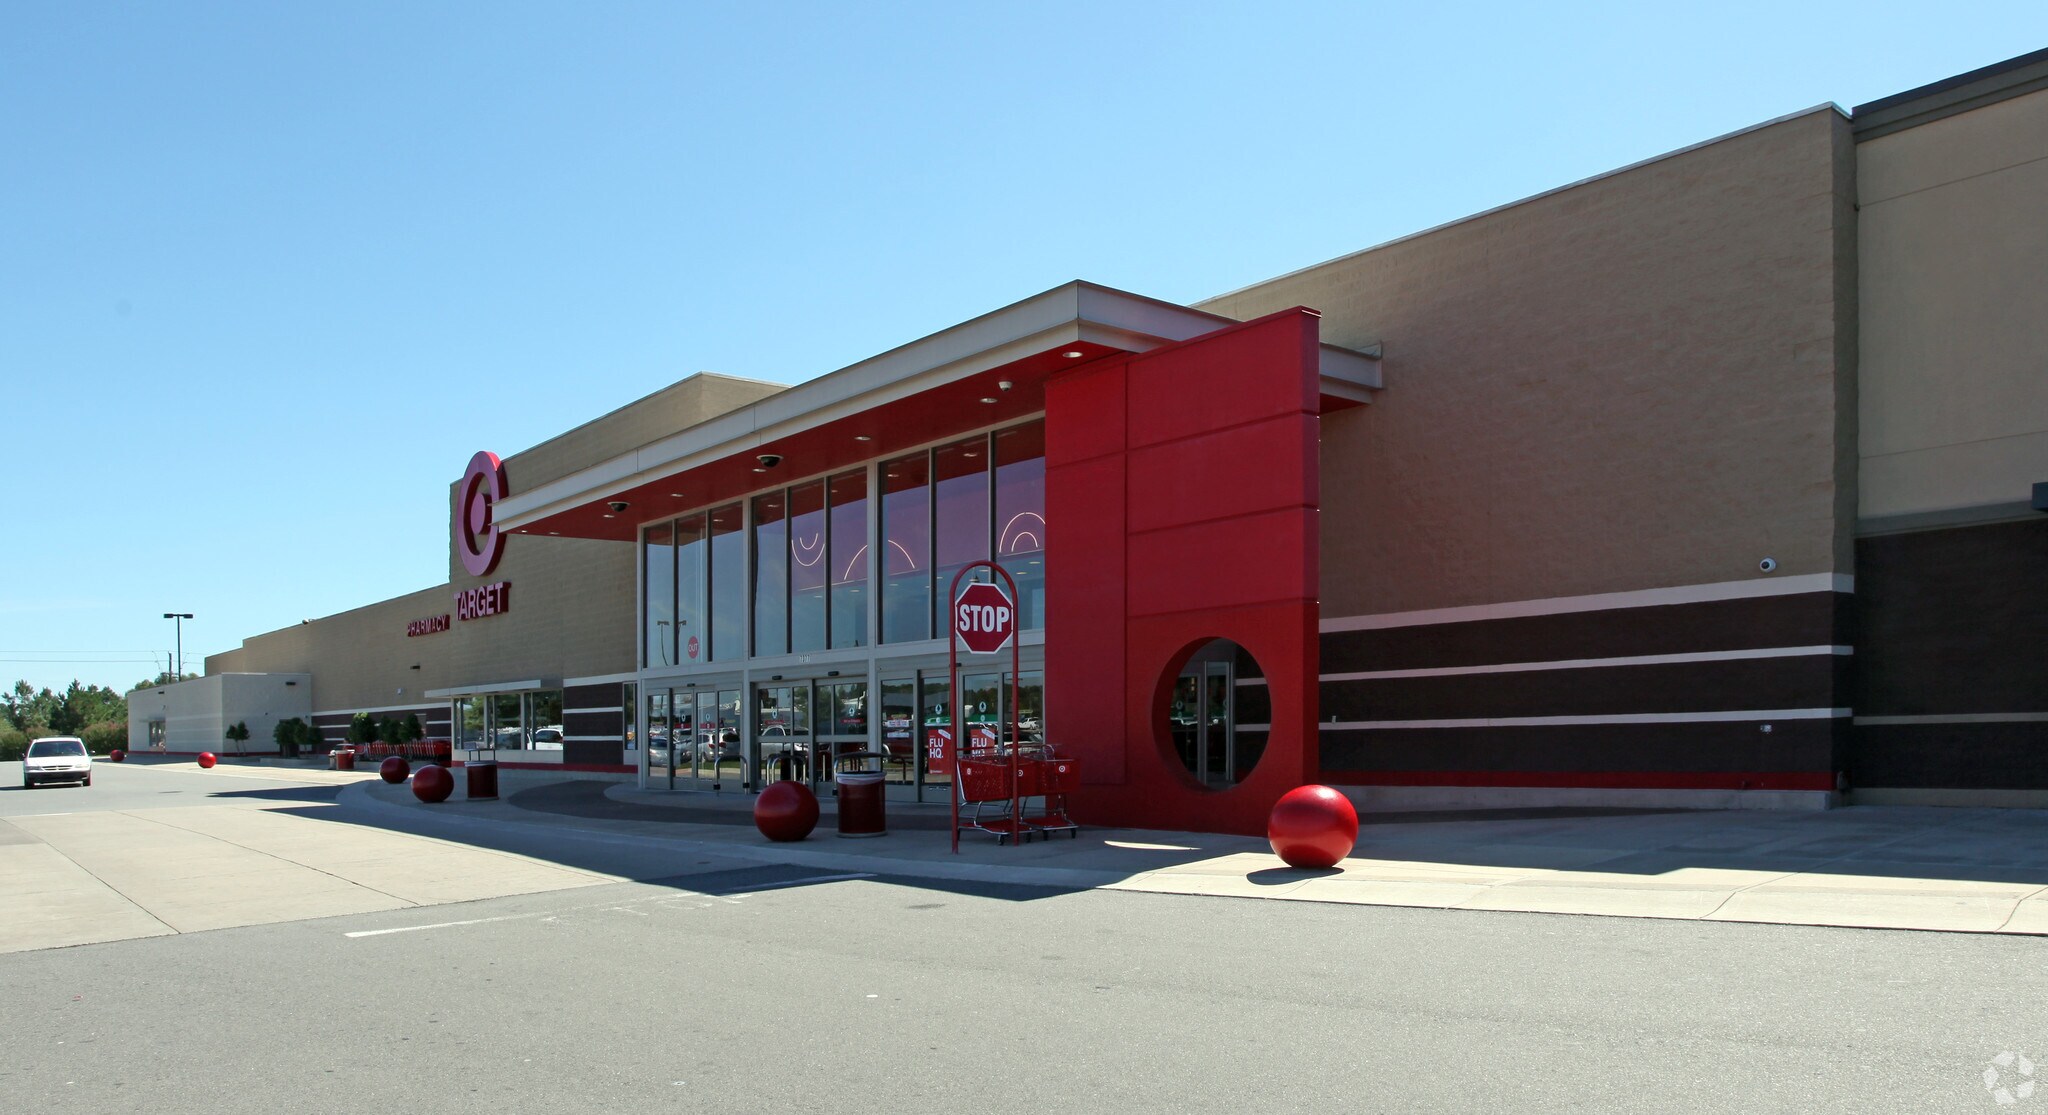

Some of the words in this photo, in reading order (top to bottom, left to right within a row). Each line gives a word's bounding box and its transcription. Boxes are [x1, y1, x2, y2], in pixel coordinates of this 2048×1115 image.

[453, 581, 507, 621] TARGET
[407, 614, 449, 637] PHARMACY
[959, 604, 1009, 633] STOP
[929, 738, 944, 748] FLU
[971, 738, 987, 747] FLU
[929, 748, 944, 758] HQ.
